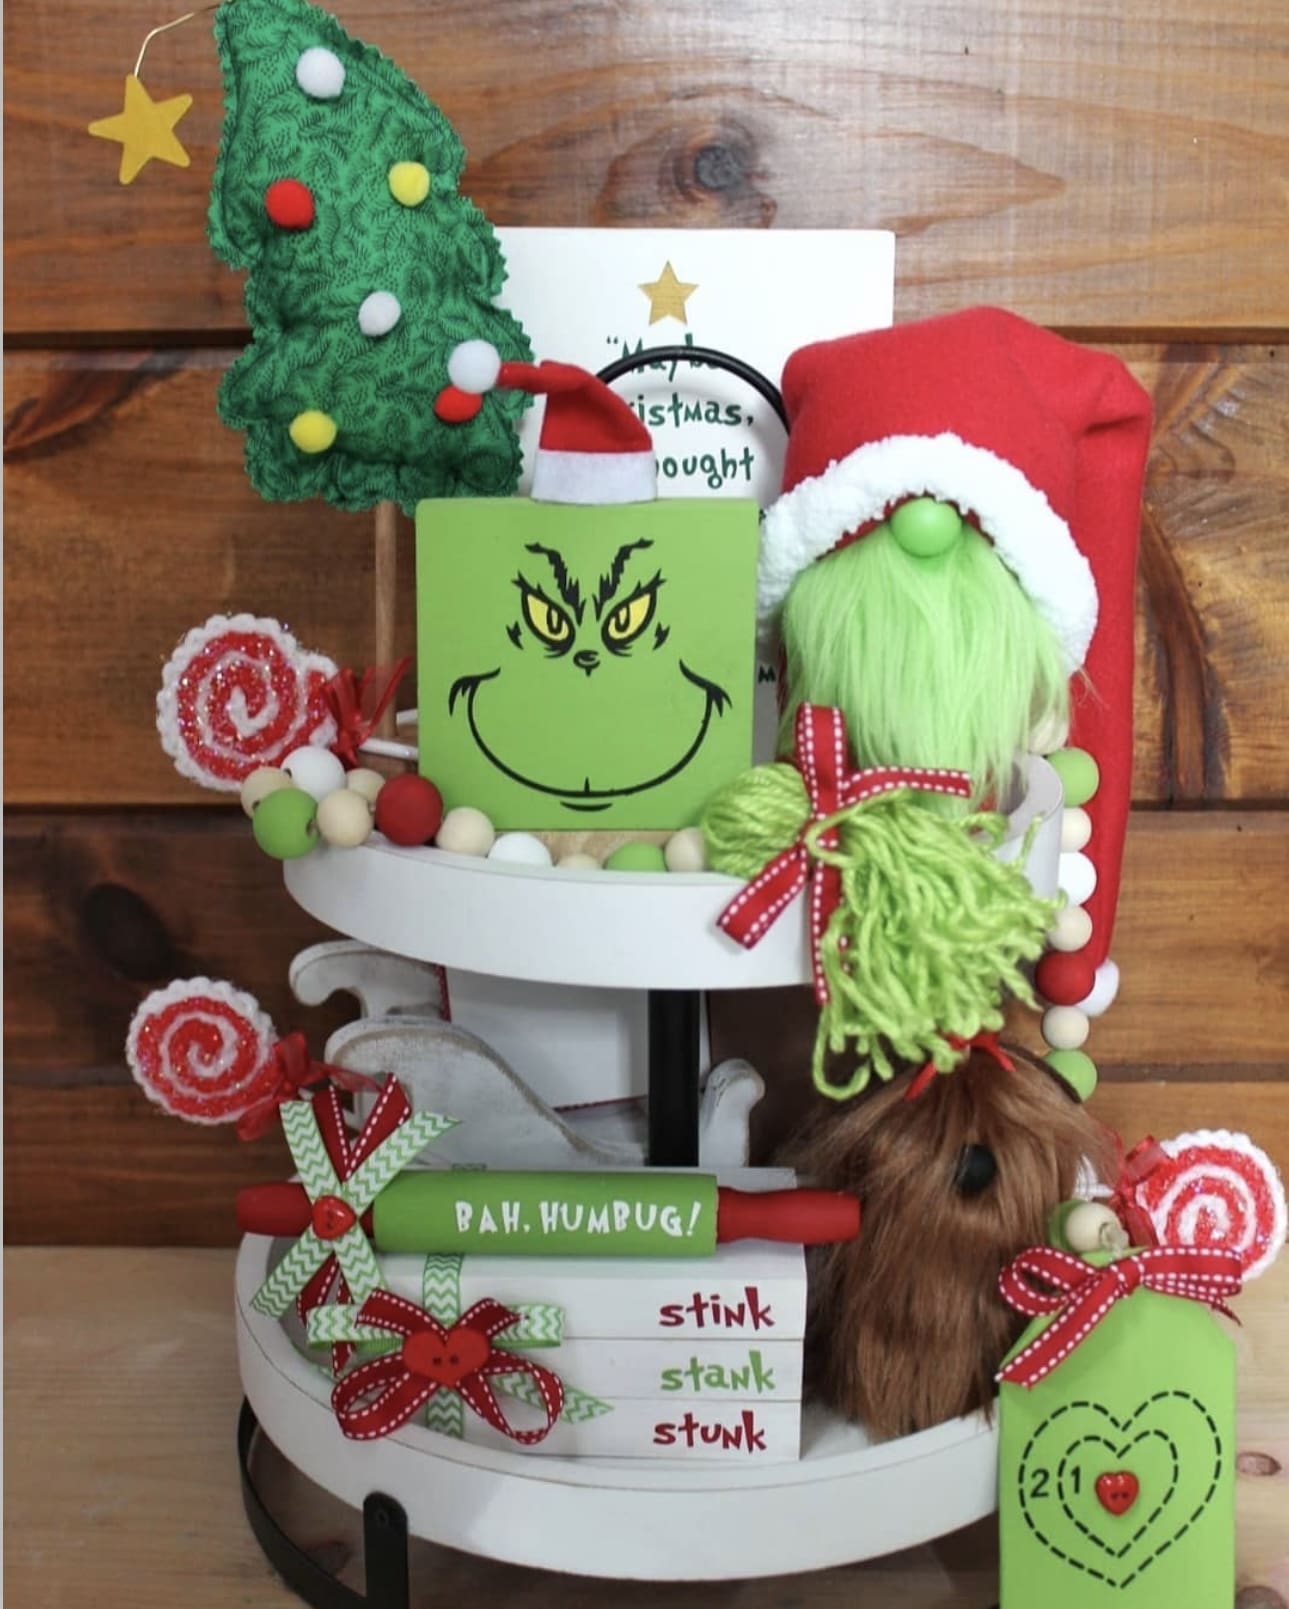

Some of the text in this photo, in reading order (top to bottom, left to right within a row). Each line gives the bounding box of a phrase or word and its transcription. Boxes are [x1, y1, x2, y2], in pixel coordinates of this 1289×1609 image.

[629, 392, 754, 428] istmas,
[655, 446, 754, 489] ought
[539, 1200, 701, 1236] HUMBUG!
[659, 1286, 775, 1330] stink
[660, 1350, 776, 1393] stank
[653, 1410, 767, 1453] stunk
